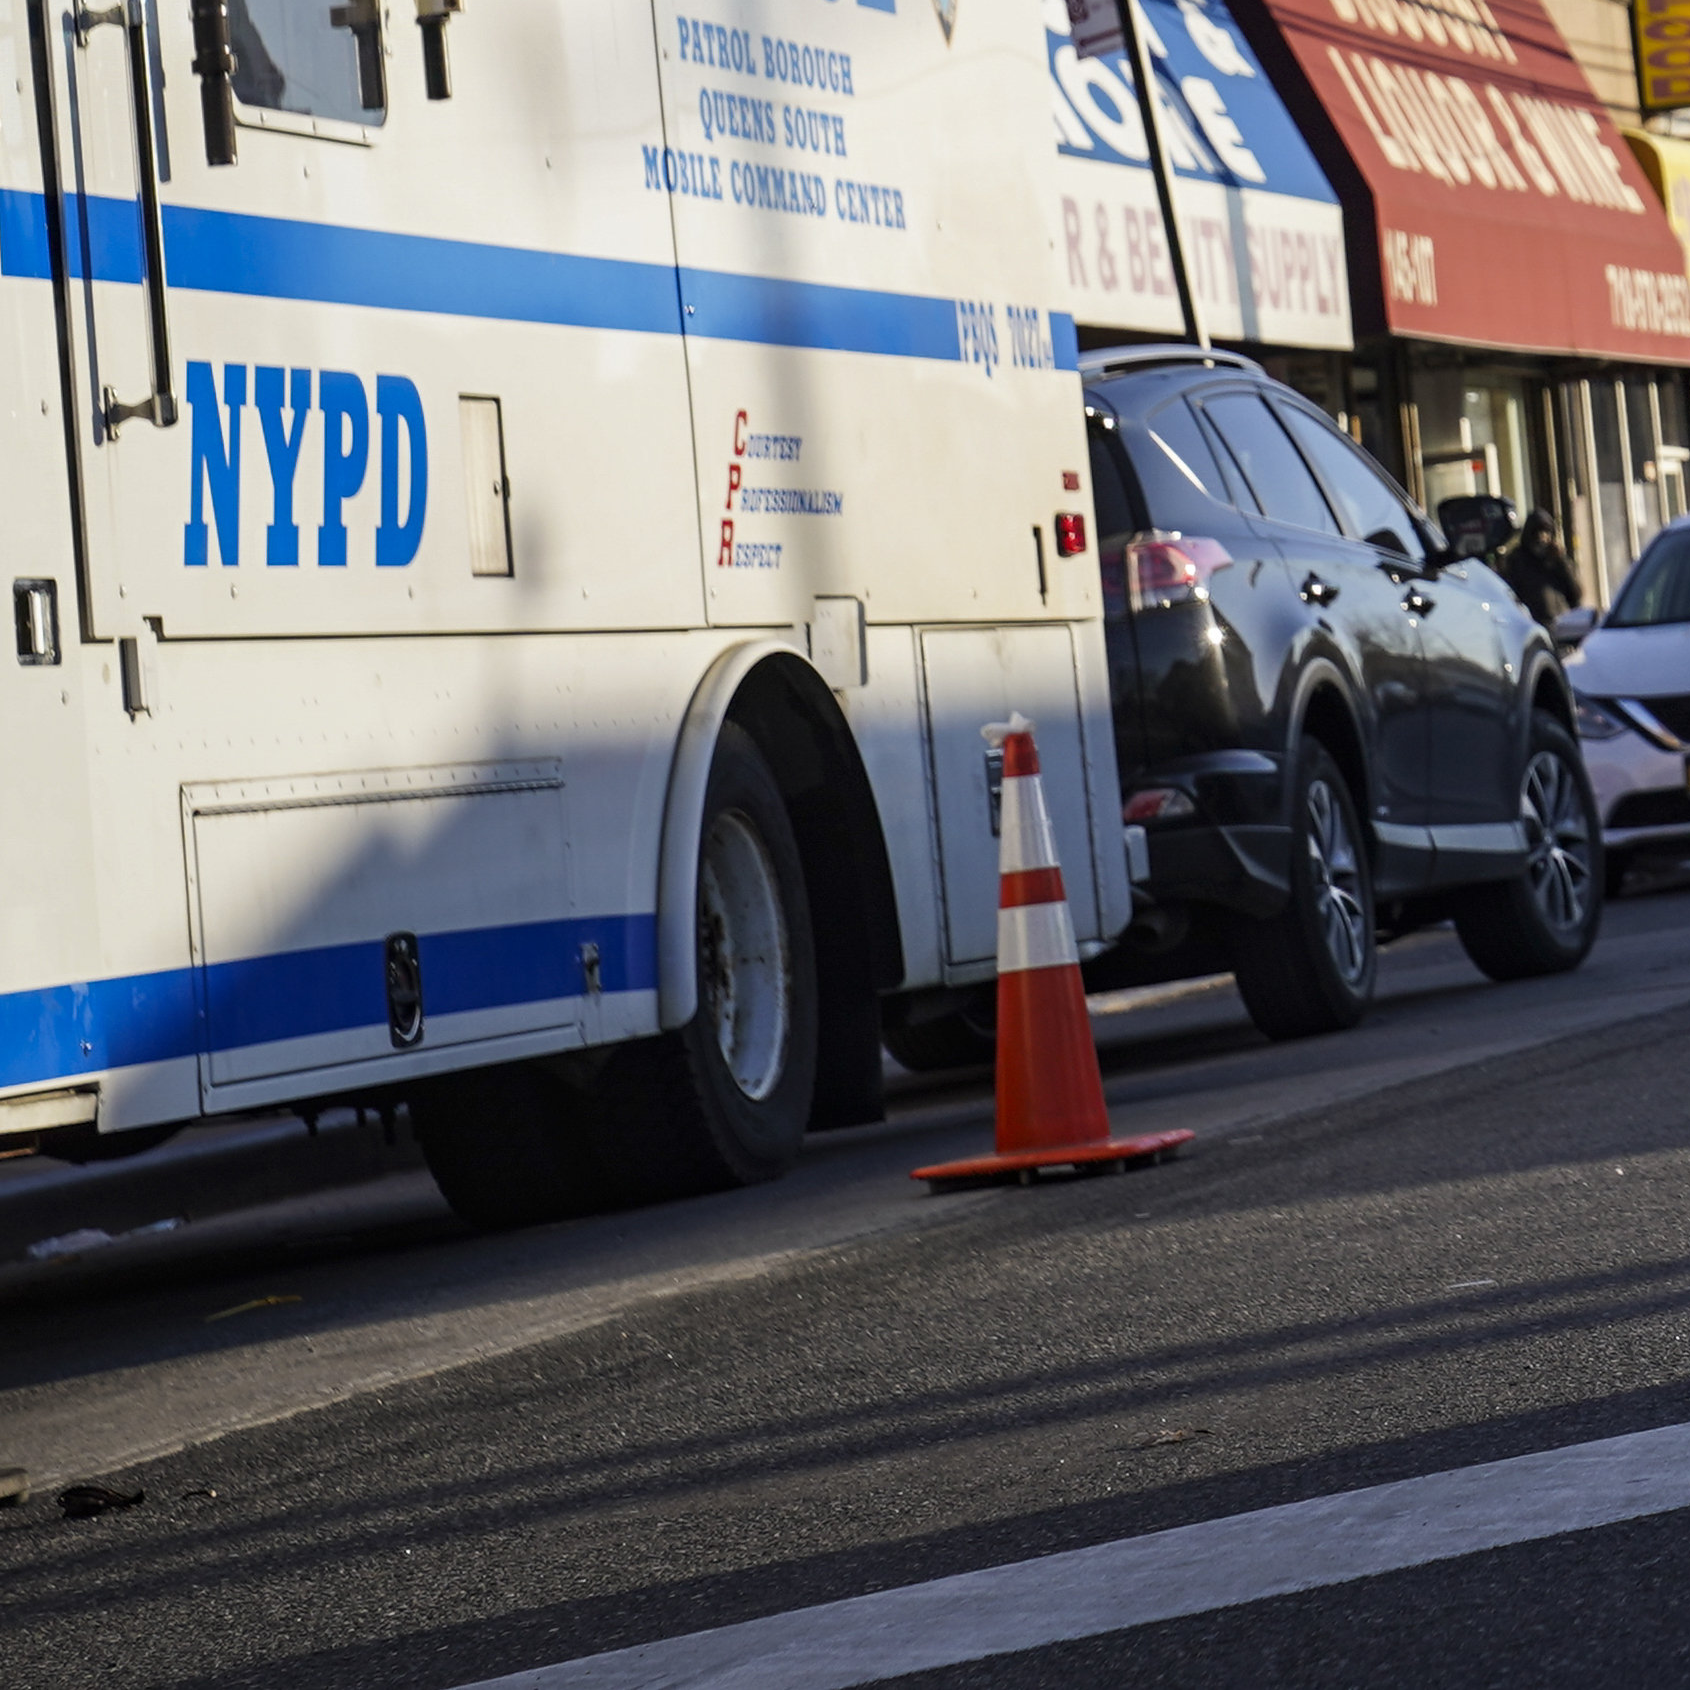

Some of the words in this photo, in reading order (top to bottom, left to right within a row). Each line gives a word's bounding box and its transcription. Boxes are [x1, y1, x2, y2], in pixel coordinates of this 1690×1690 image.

[676, 14, 758, 76] PATROL
[761, 34, 854, 97] BOROUGH
[699, 86, 776, 144] QUEENS
[783, 104, 847, 158] SOUTH
[1326, 44, 1529, 192] LIQUOR
[1484, 83, 1559, 197] &
[1510, 90, 1647, 215] WINE
[642, 143, 723, 201] MOBILE
[730, 159, 827, 217] COMMAND
[835, 177, 906, 230] CENTER
[1096, 200, 1119, 294] &
[1244, 222, 1342, 319] SUPPLY
[184, 359, 430, 569] NYPD
[734, 408, 803, 462] COURTESY
[717, 518, 783, 570] RESPECT
